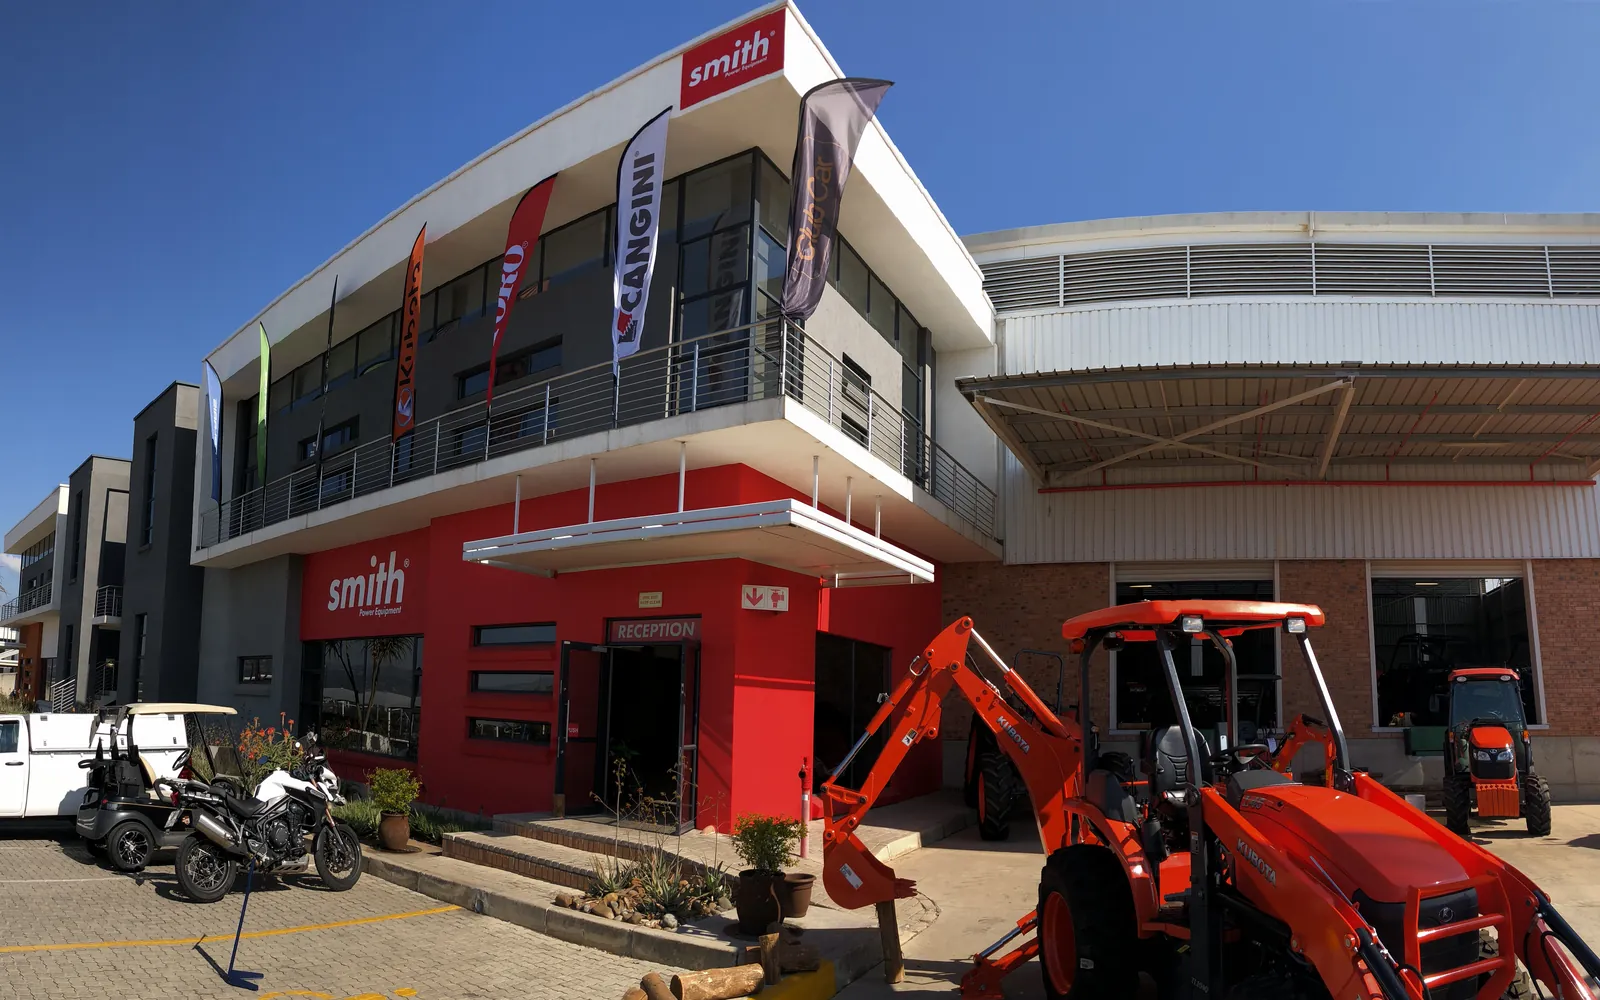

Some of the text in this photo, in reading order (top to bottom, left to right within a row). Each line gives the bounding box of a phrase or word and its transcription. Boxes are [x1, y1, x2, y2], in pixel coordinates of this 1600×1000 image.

[688, 30, 769, 87] smith
[621, 153, 655, 313] CANGINI
[493, 244, 524, 346] ORO
[327, 550, 405, 611] smith
[359, 605, 402, 617] Power Equipment
[618, 621, 695, 638] RECEPTION
[997, 715, 1030, 754] KUBOTA
[1237, 838, 1277, 887] KUBOTA
